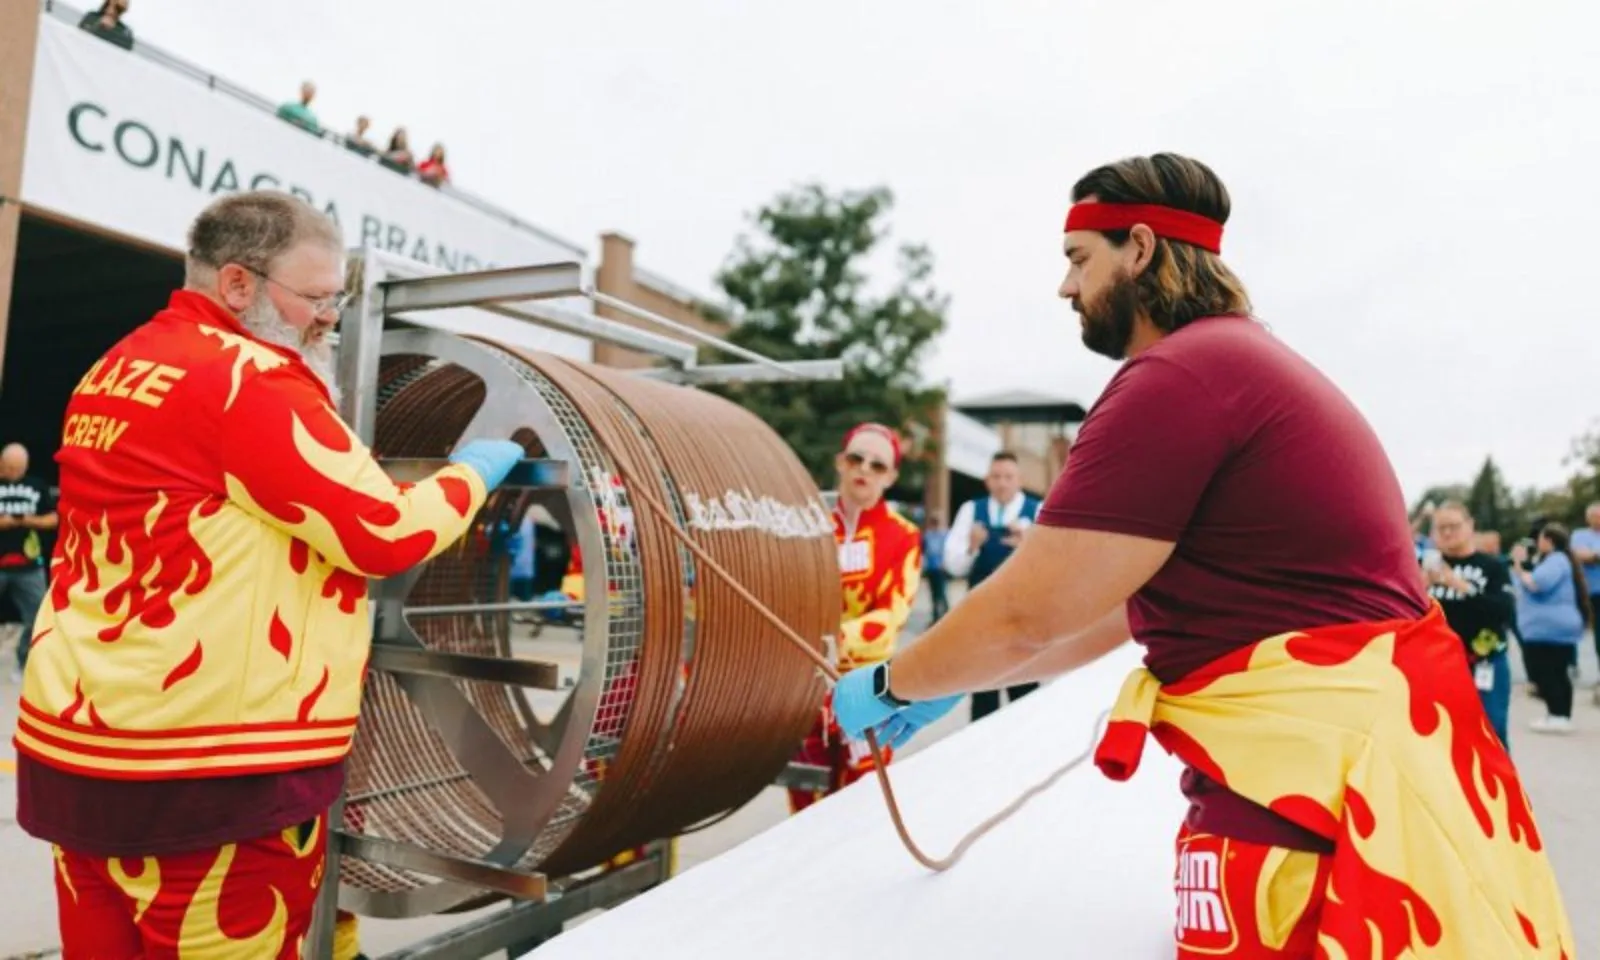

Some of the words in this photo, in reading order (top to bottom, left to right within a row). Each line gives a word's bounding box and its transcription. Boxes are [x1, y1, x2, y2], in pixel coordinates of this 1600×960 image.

[68, 102, 340, 228] CONA
[361, 214, 497, 273] BRAND
[73, 357, 187, 408] LAZE
[63, 414, 130, 452] CREW
